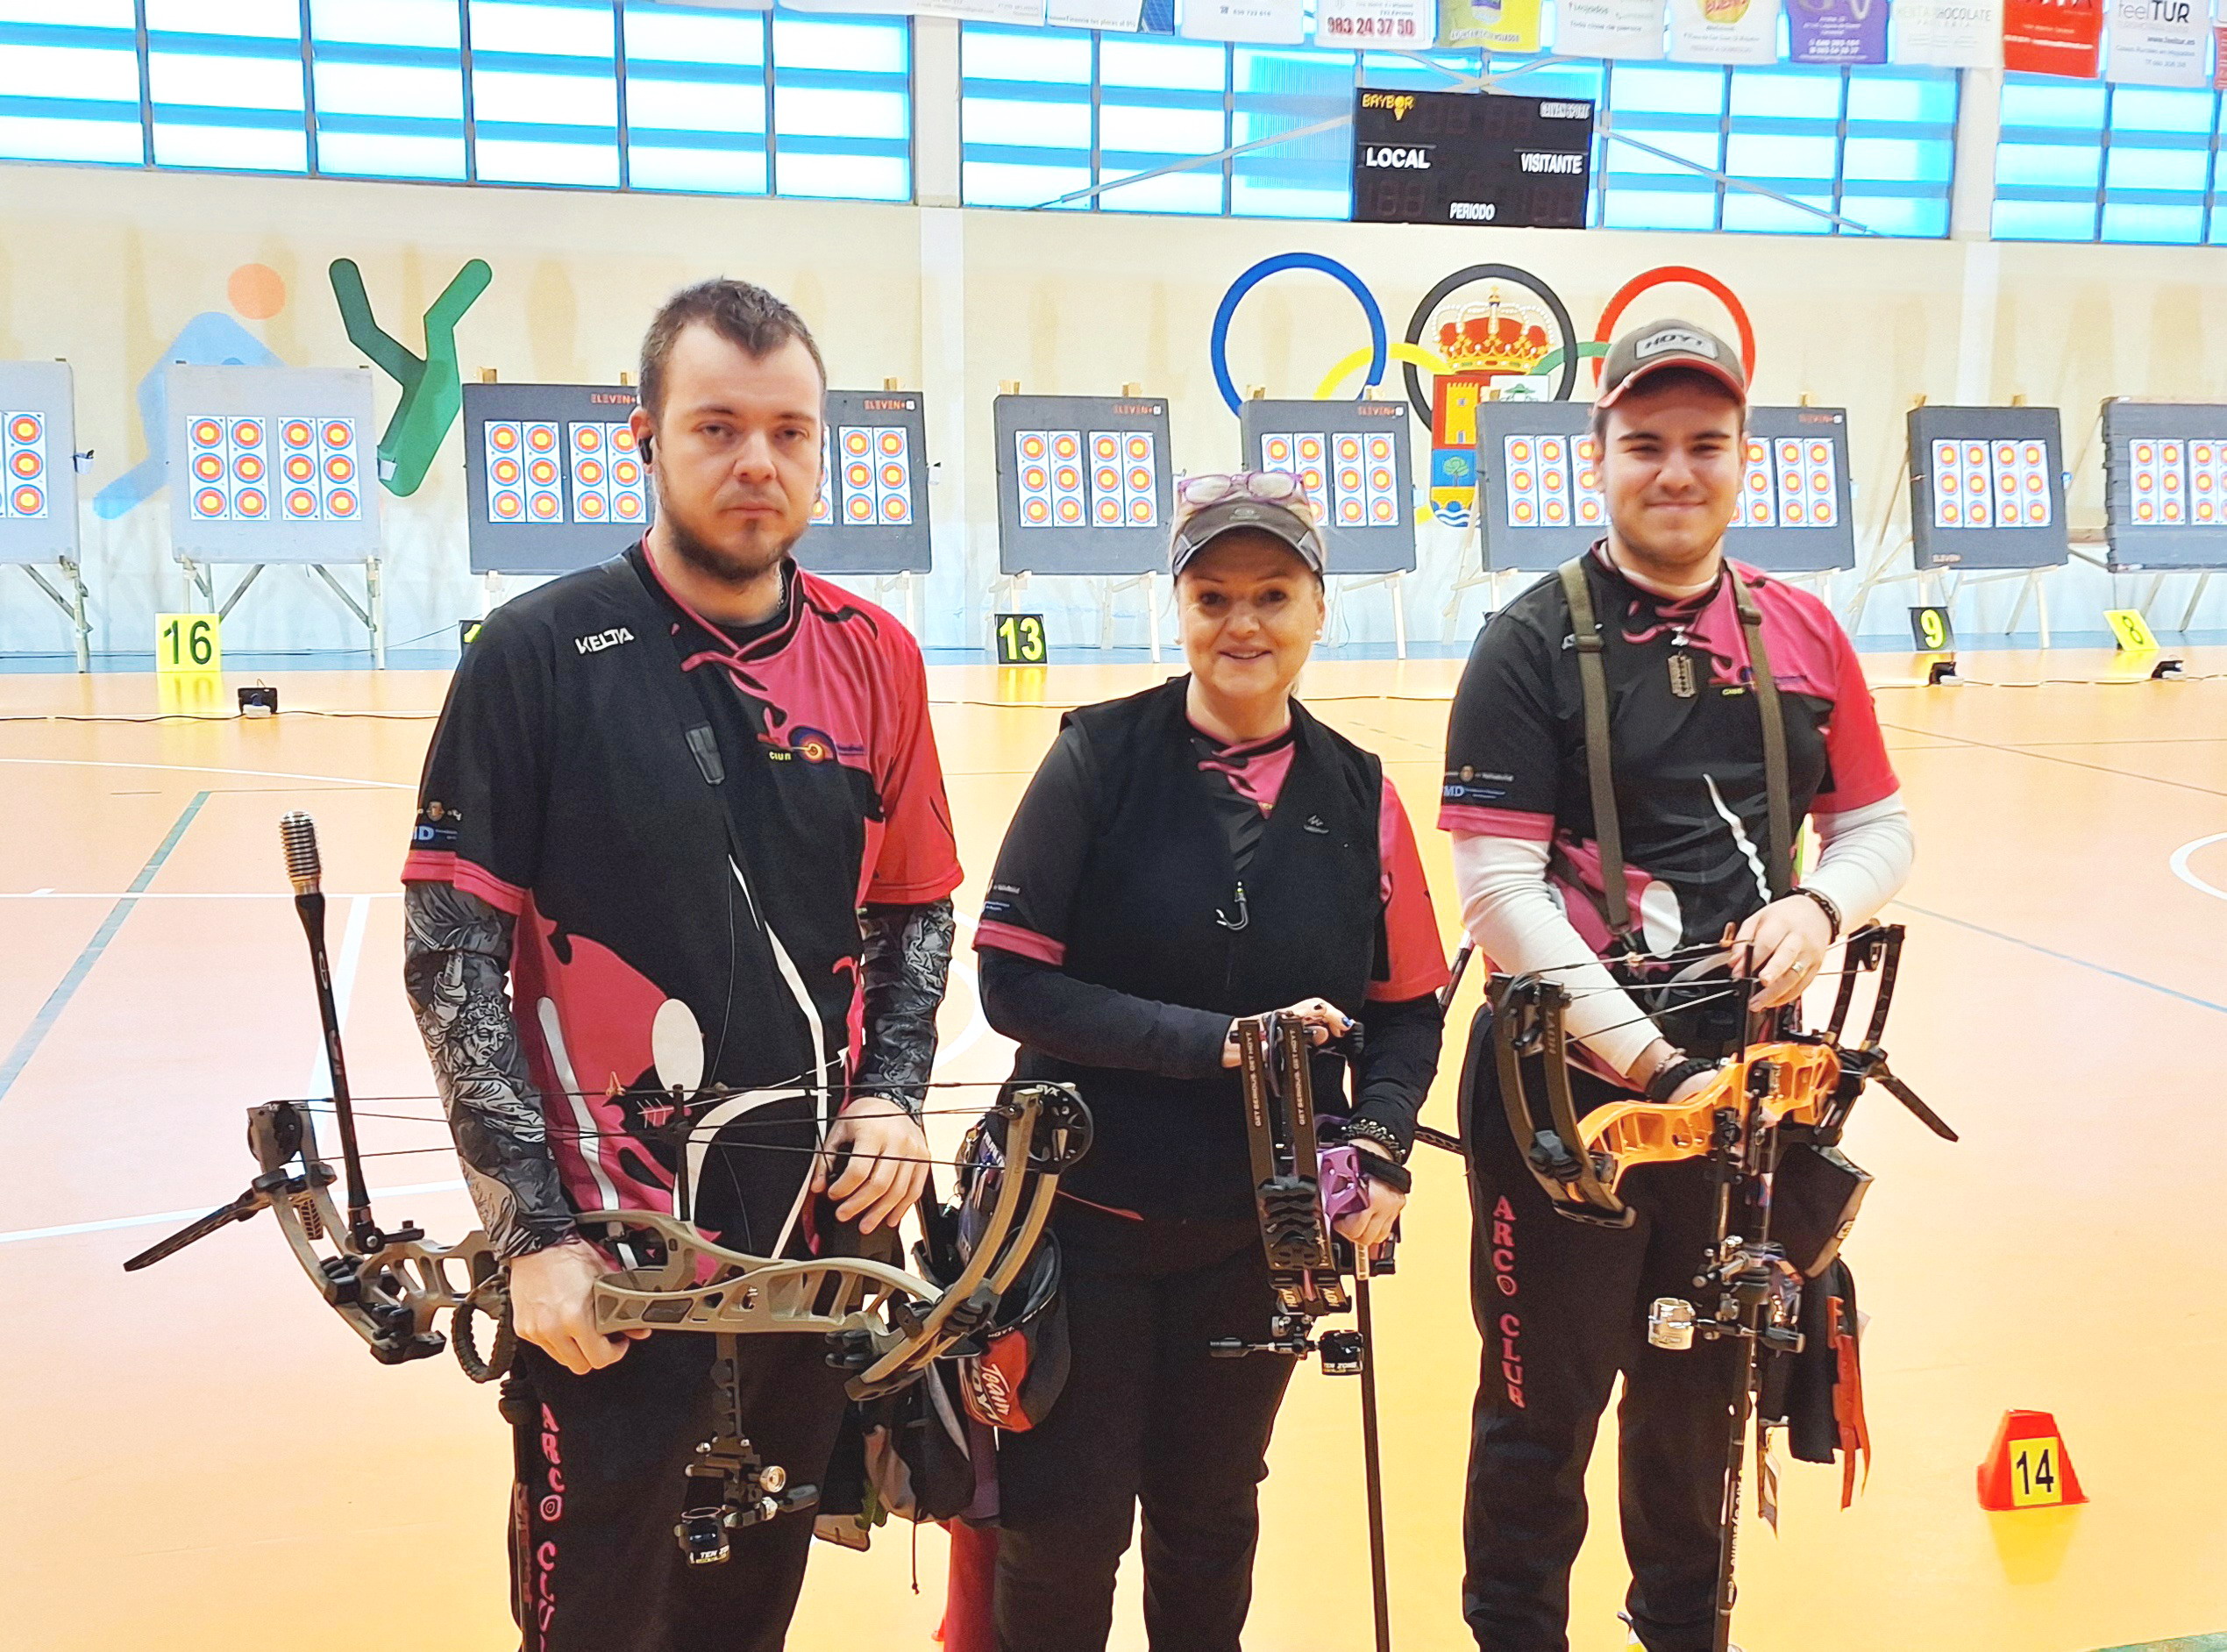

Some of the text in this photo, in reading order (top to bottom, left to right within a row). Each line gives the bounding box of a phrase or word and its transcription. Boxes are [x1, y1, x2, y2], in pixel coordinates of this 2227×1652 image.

[1327, 17, 1413, 35] 983 24 37 50
[1366, 146, 1431, 169] LOCAL
[1520, 153, 1583, 174] VISITANTE
[1449, 202, 1496, 220] PERIODO
[590, 394, 630, 403] ELEVEN
[163, 619, 212, 665] 16
[1000, 617, 1042, 660] 13
[1920, 609, 1944, 648] 9
[2122, 616, 2144, 644] 8
[1254, 1110, 1263, 1127] GET
[1492, 1194, 1526, 1409] ARCO CLUB
[540, 1403, 566, 1521] ARCO
[2016, 1449, 2054, 1495] 14
